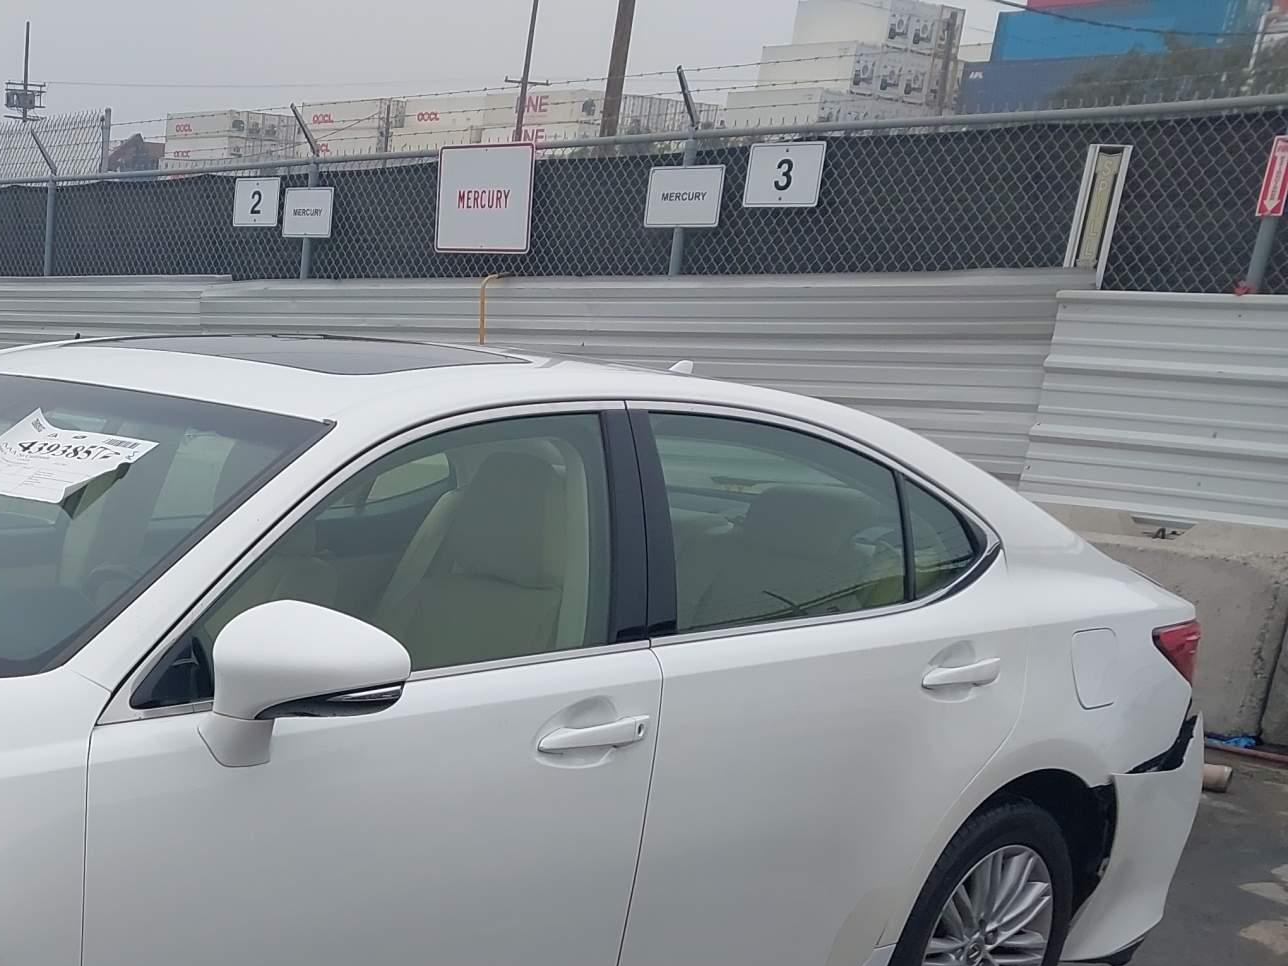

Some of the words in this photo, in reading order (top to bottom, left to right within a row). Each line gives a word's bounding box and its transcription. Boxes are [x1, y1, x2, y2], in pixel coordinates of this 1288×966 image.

[515, 95, 549, 113] NE
[774, 159, 794, 191] 3
[249, 190, 262, 215] 2
[457, 190, 511, 209] MERCURY
[662, 191, 708, 202] MERCURY
[292, 208, 323, 217] MERCURY
[1085, 160, 1114, 257] SPILL
